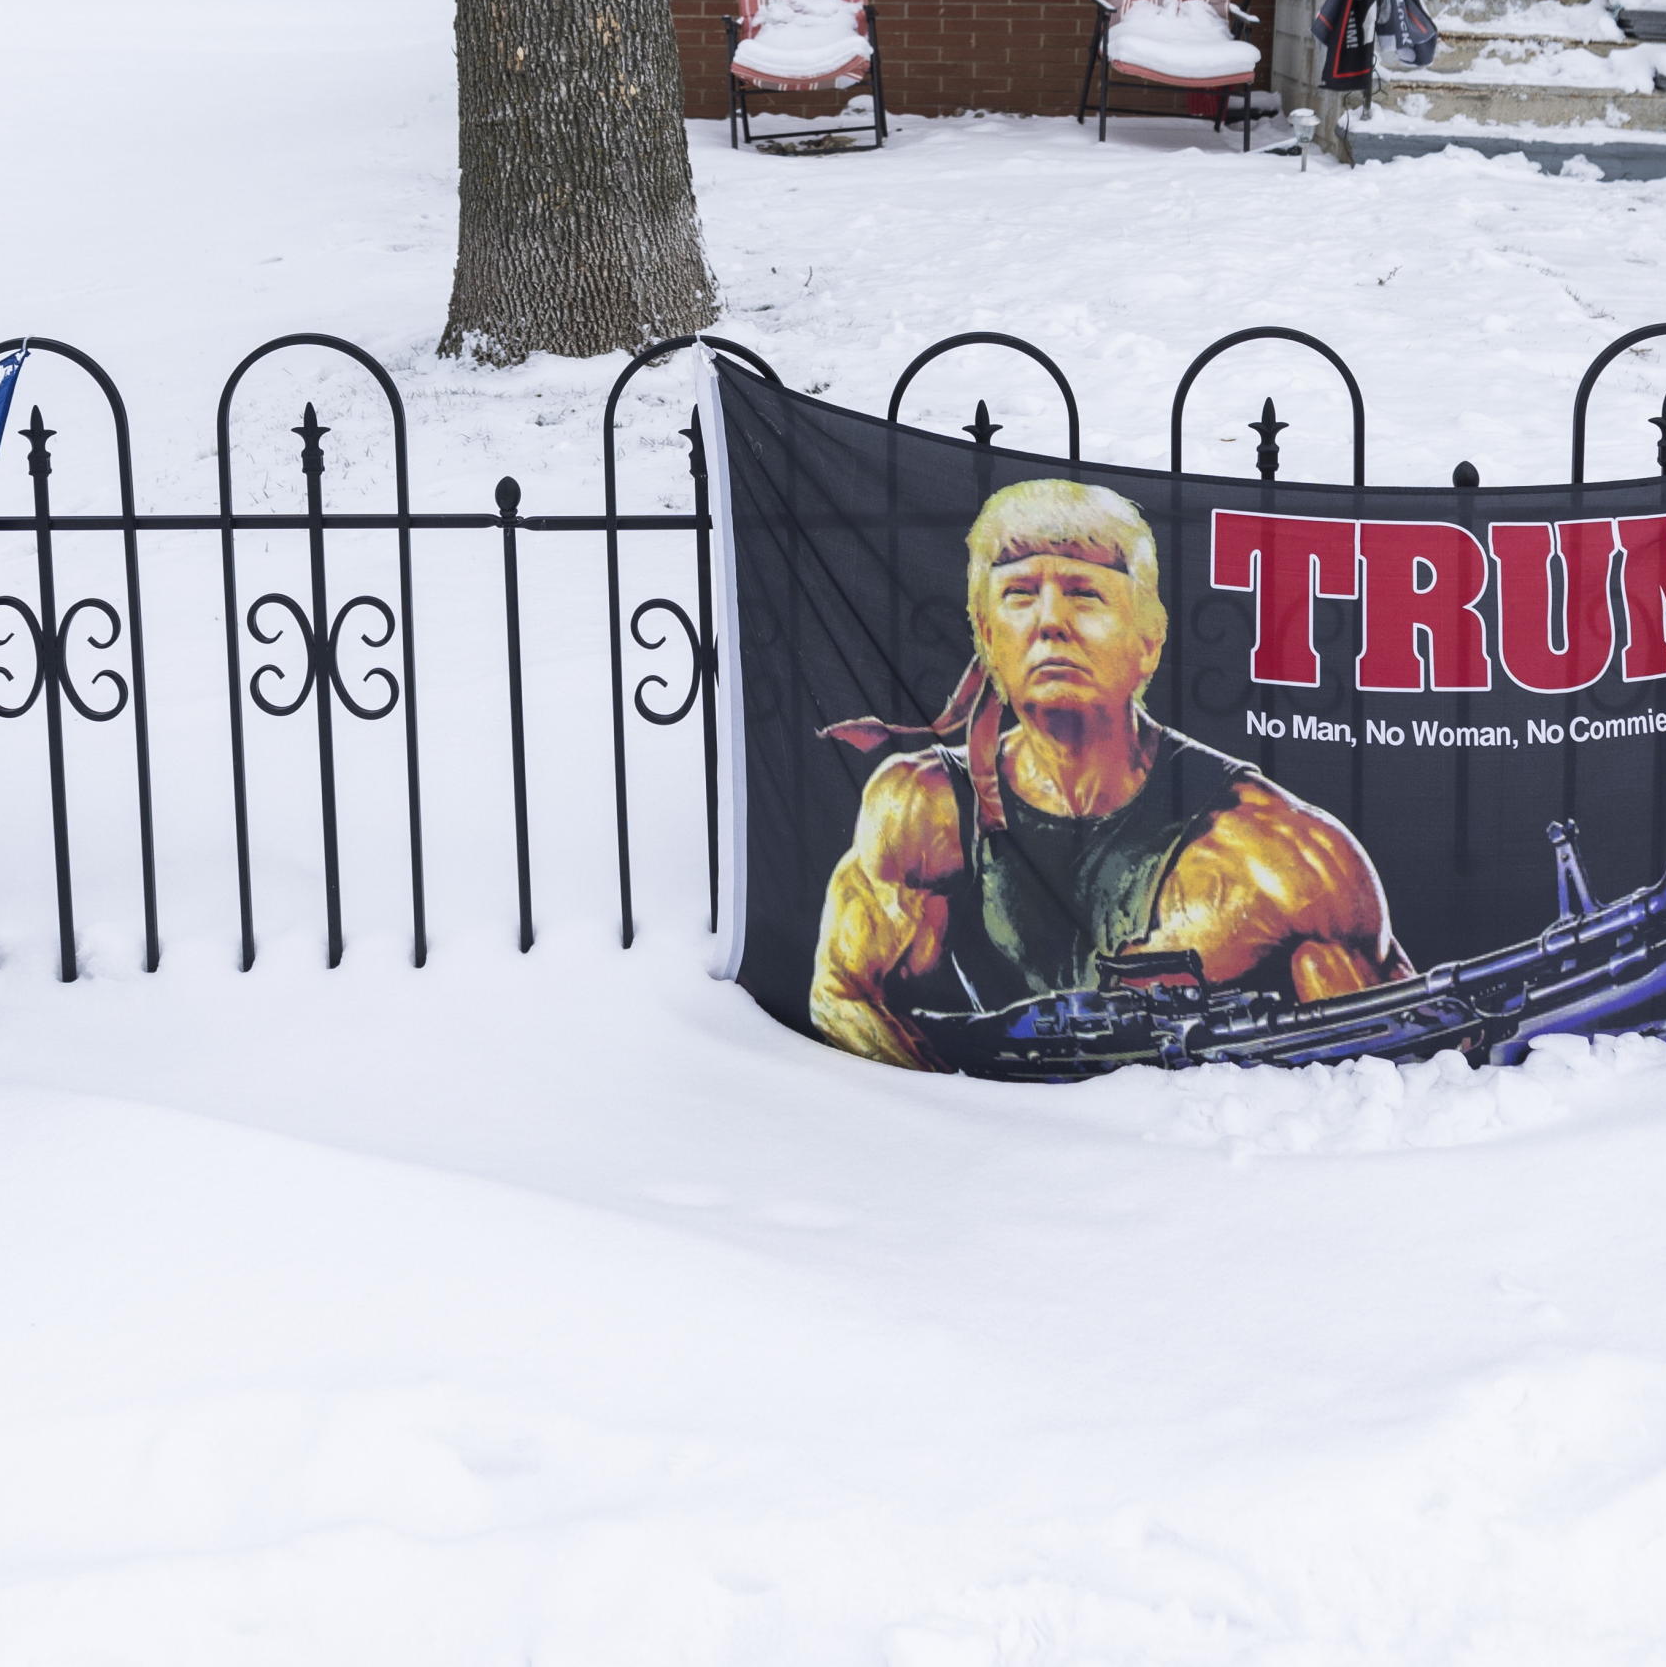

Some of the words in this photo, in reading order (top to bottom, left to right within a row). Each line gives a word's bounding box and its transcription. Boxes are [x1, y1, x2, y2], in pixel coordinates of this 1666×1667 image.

[1246, 710, 1286, 738] No
[1292, 714, 1357, 747] Man,
[1366, 719, 1405, 746] No
[1412, 720, 1518, 750] Woman,
[1527, 719, 1564, 744] No
